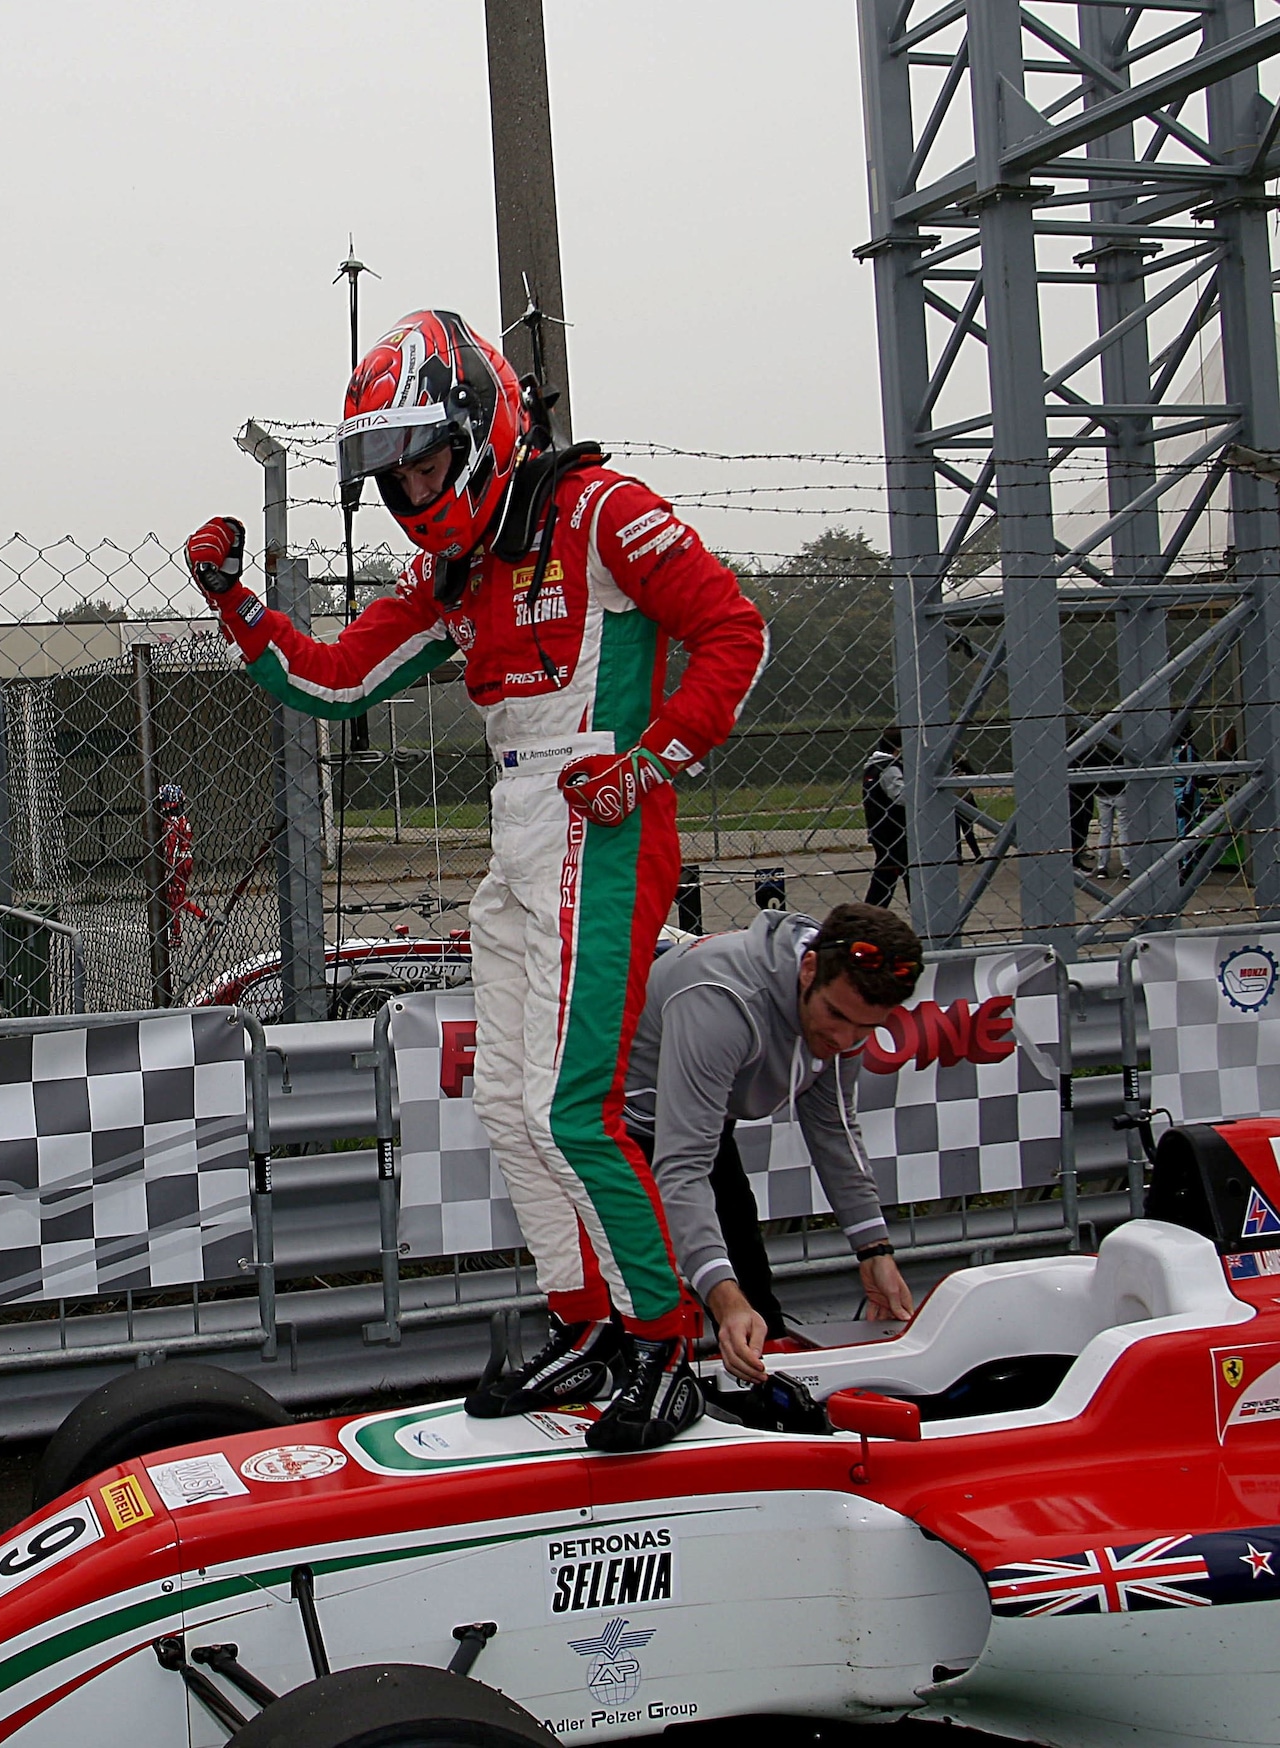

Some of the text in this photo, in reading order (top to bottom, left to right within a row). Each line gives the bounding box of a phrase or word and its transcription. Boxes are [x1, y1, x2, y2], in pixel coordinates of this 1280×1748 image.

[529, 746, 573, 761] Armstrong
[1239, 967, 1269, 978] MONZA
[848, 994, 1017, 1076] ONE
[553, 1367, 593, 1395] sparco
[108, 1481, 145, 1524] PIRELLI
[549, 1528, 671, 1561] PETRONAS
[552, 1551, 672, 1613] SELENIA
[543, 1701, 698, 1736] Adler Pelzer Group
